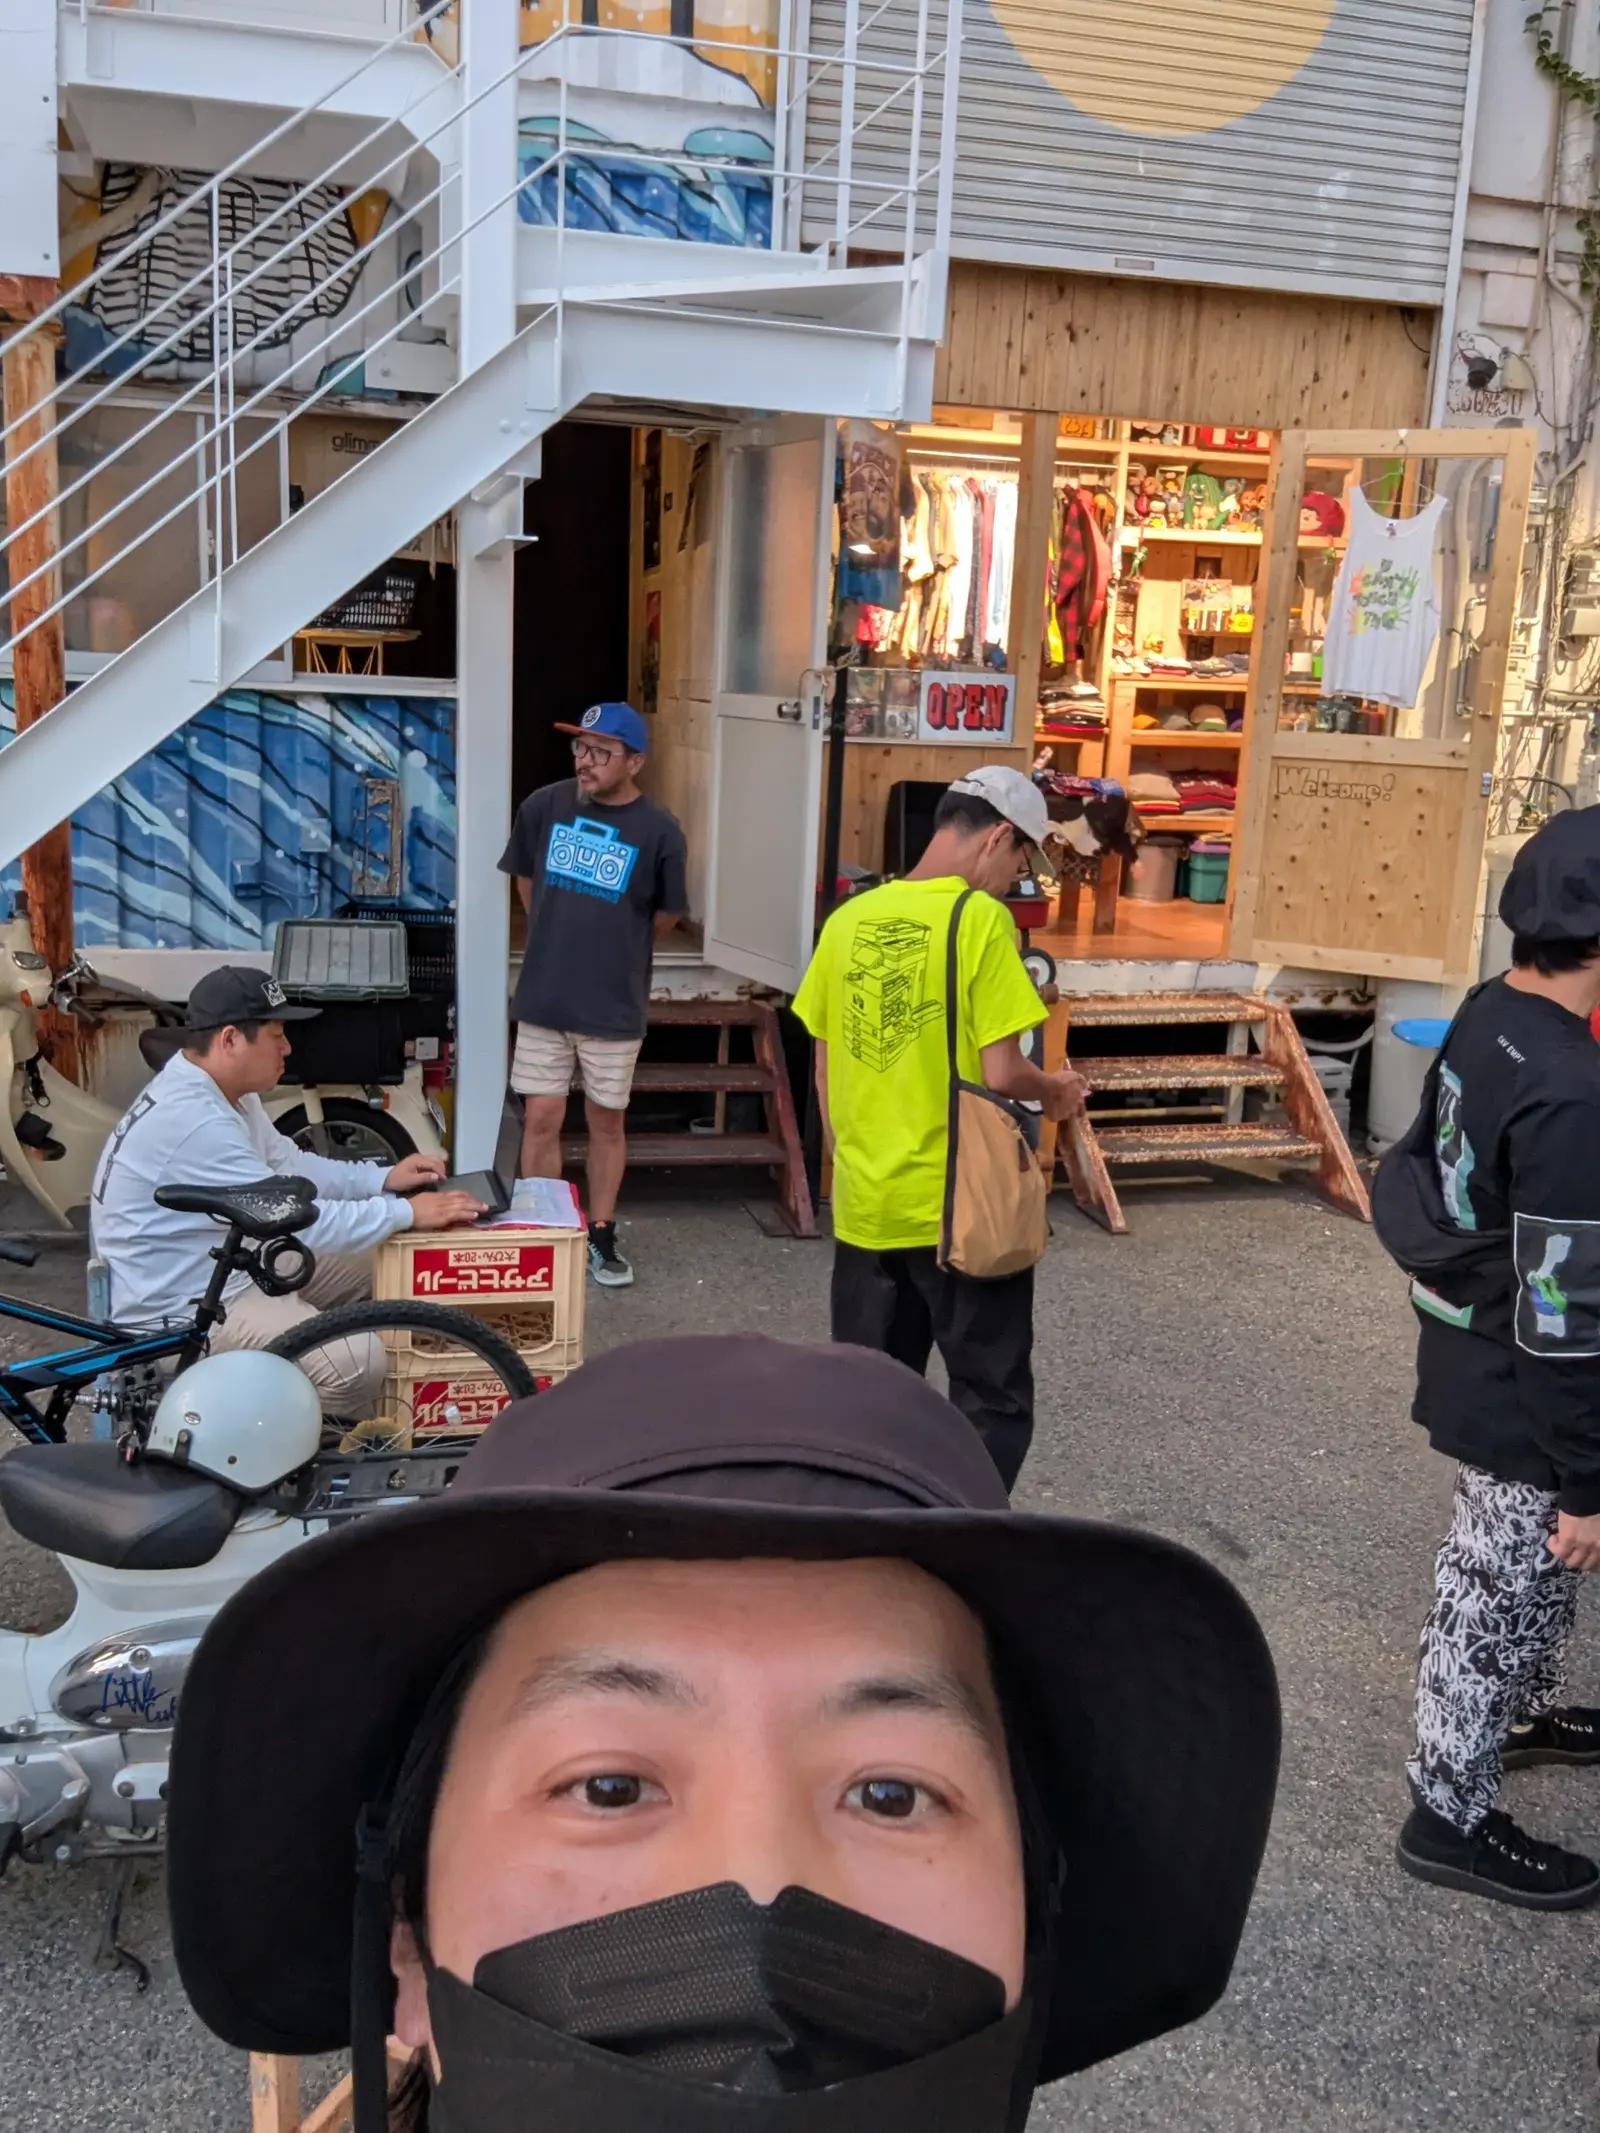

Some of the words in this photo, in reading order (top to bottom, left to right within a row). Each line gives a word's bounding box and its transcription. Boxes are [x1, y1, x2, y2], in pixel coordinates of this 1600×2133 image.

[926, 682, 1008, 732] OPEN
[1276, 765, 1396, 801] Welcome!
[1506, 1045, 1526, 1063] EMPT
[417, 1267, 549, 1292] アサヒビール
